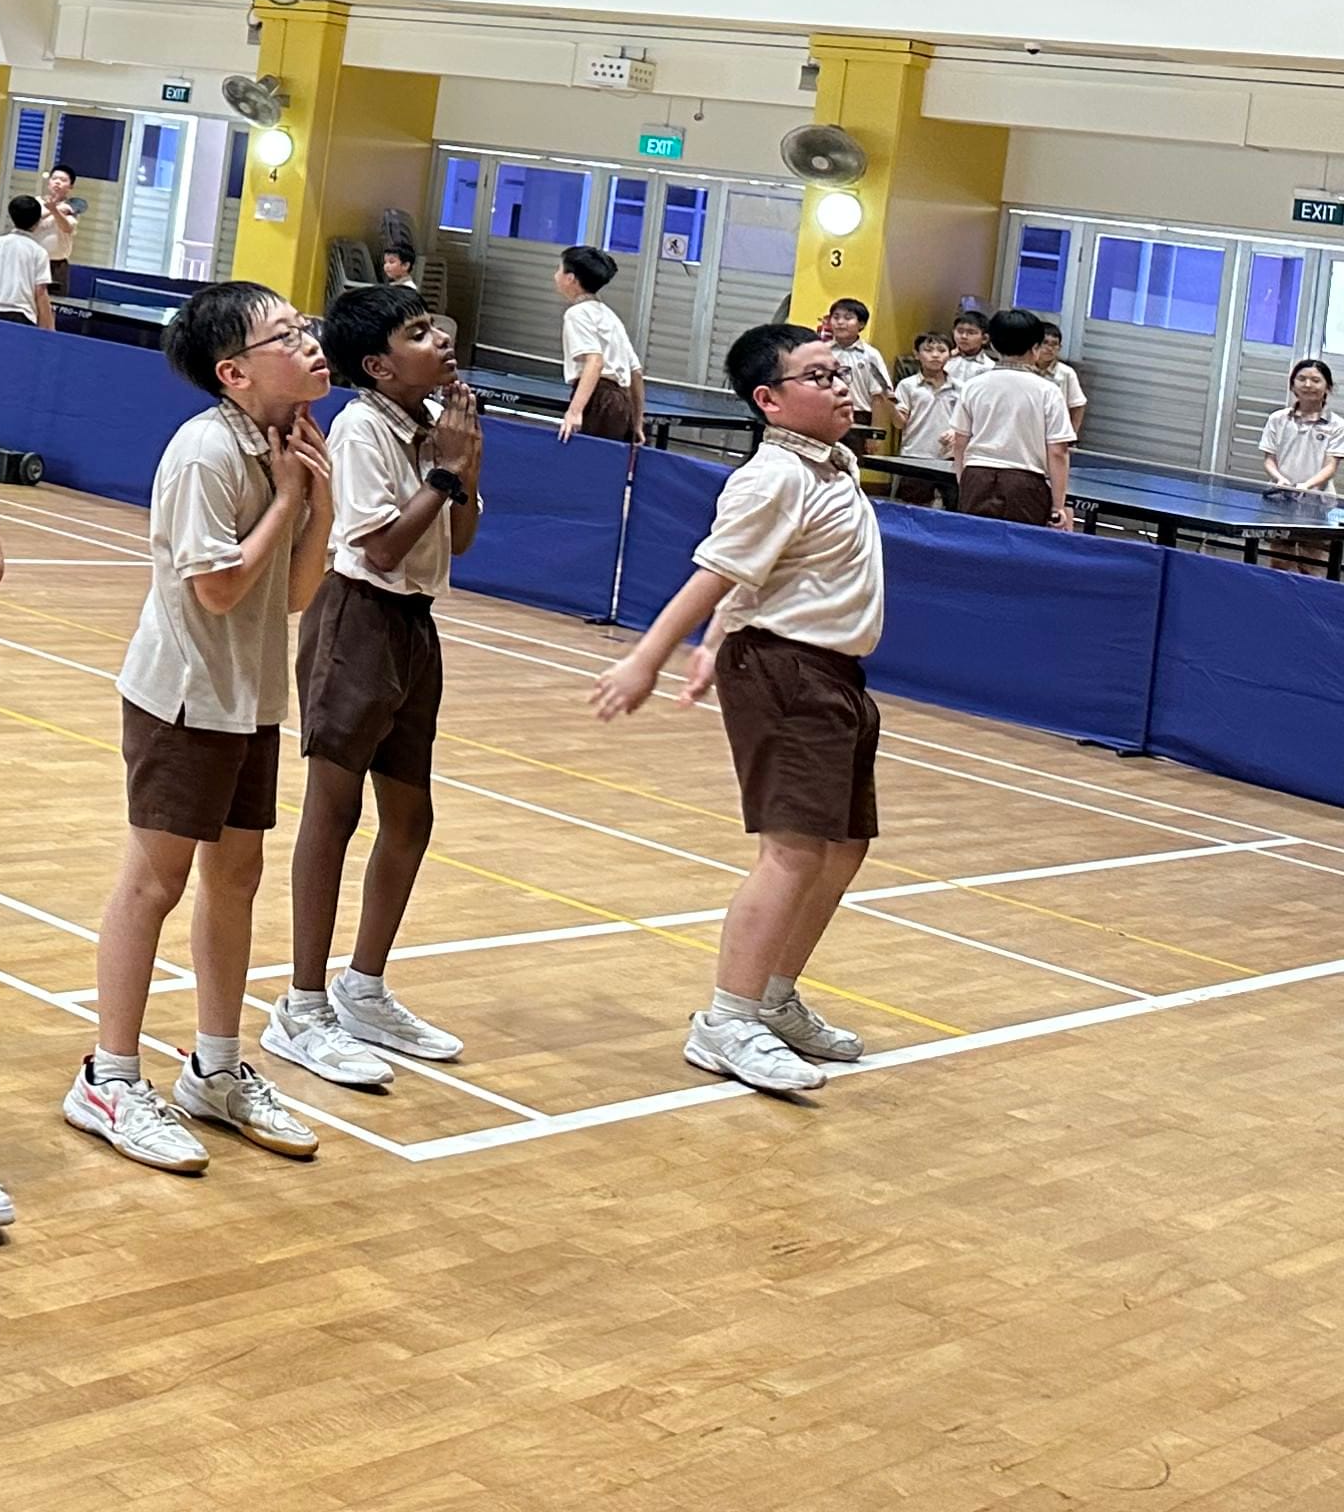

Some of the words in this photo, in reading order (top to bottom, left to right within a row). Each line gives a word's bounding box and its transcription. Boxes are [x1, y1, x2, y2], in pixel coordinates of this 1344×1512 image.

[165, 87, 186, 100] EXIT
[647, 138, 674, 155] EXIT
[269, 168, 278, 182] 4
[1301, 202, 1337, 222] EXIT
[831, 249, 842, 267] 3
[1066, 499, 1100, 512] -TOP
